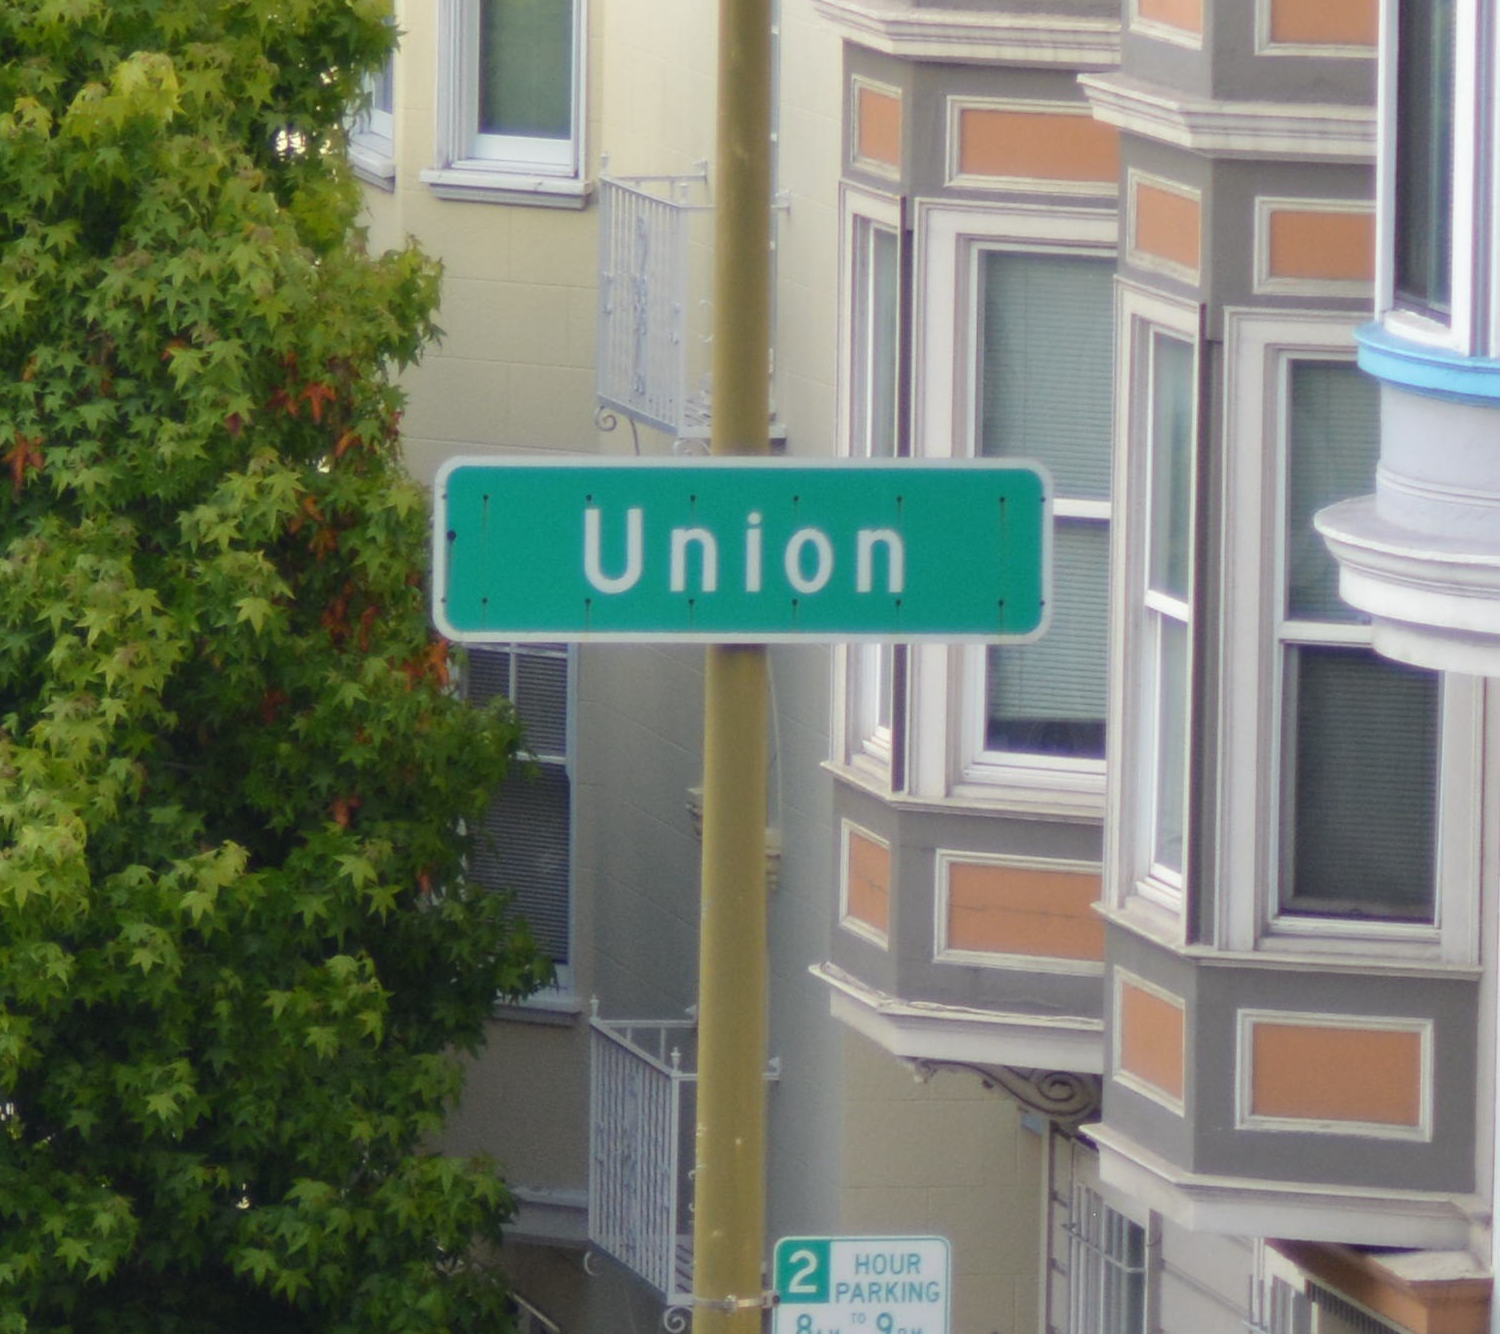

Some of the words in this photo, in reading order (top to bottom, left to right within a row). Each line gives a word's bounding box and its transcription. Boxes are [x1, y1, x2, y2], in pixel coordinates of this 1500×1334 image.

[581, 506, 907, 594] Union
[787, 1249, 819, 1294] 2
[854, 1252, 921, 1275] HOUR
[835, 1281, 940, 1304] PARKING
[851, 1313, 867, 1325] TO
